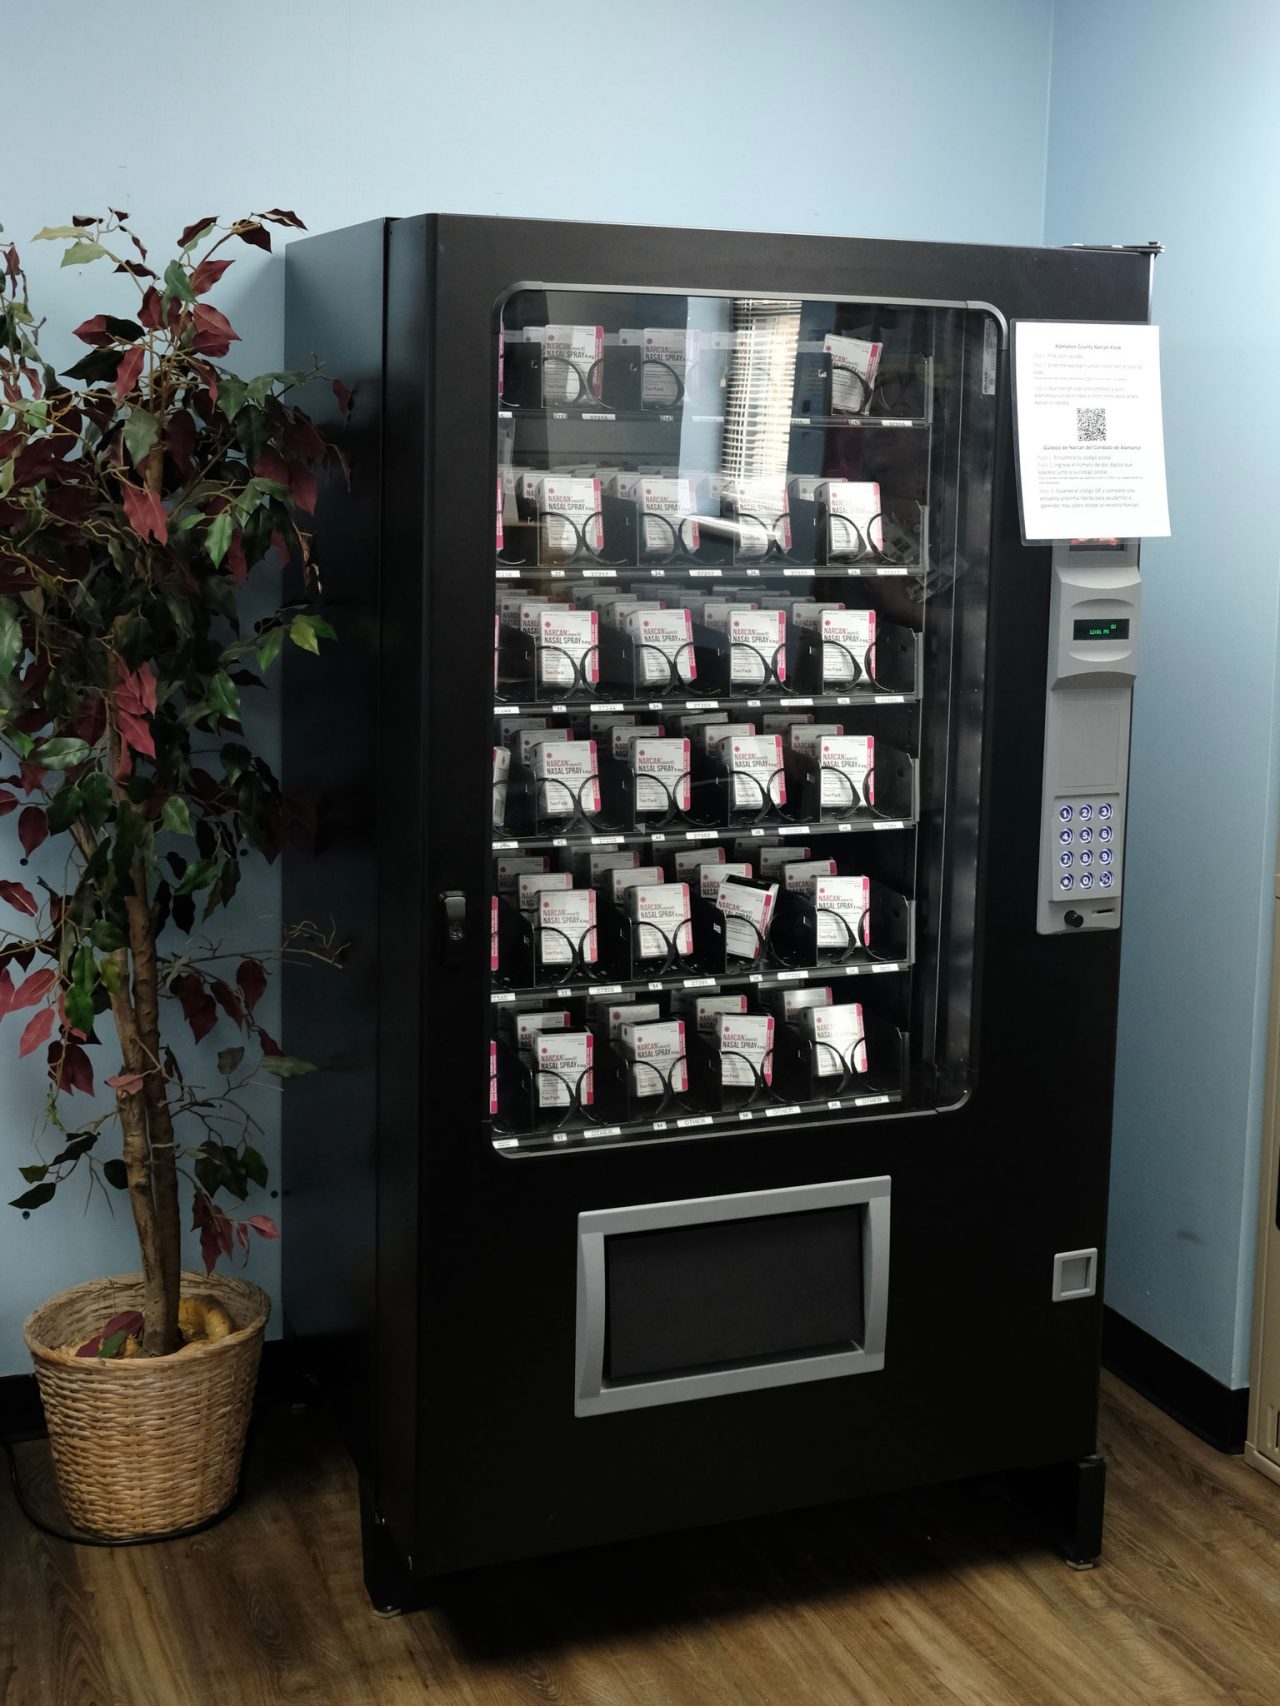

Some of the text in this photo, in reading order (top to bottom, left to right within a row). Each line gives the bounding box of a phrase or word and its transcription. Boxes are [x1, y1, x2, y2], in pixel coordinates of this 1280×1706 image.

[547, 767, 565, 775] NASAL
[1062, 832, 1068, 840] 4
[718, 901, 739, 911] NARCAN
[655, 1049, 671, 1057] SPRAY
[684, 1118, 705, 1126] OTHER
